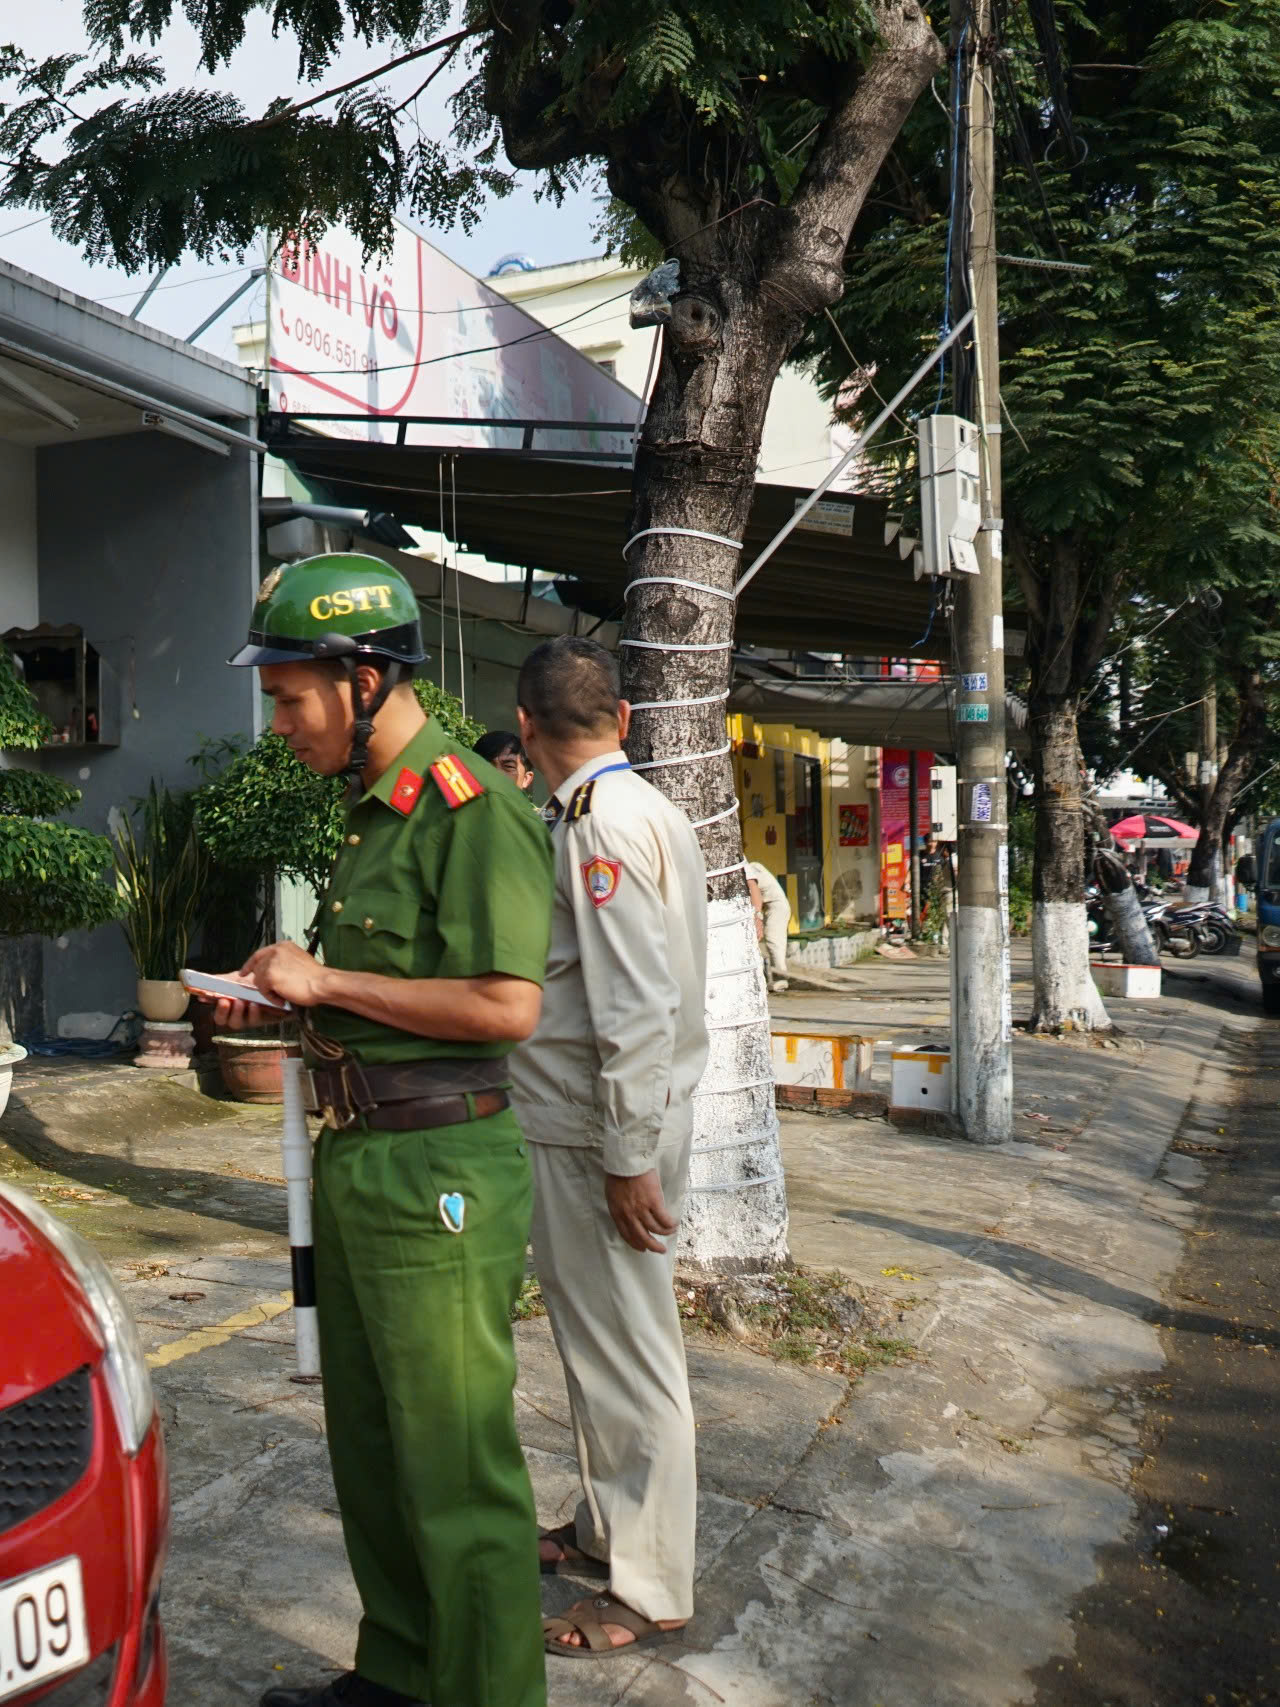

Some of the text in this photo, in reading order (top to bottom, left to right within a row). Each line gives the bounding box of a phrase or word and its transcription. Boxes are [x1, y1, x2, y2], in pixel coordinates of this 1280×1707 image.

[360, 274, 398, 341] VÕ
[295, 317, 378, 383] 0906.551.911
[310, 585, 392, 620] CSTT
